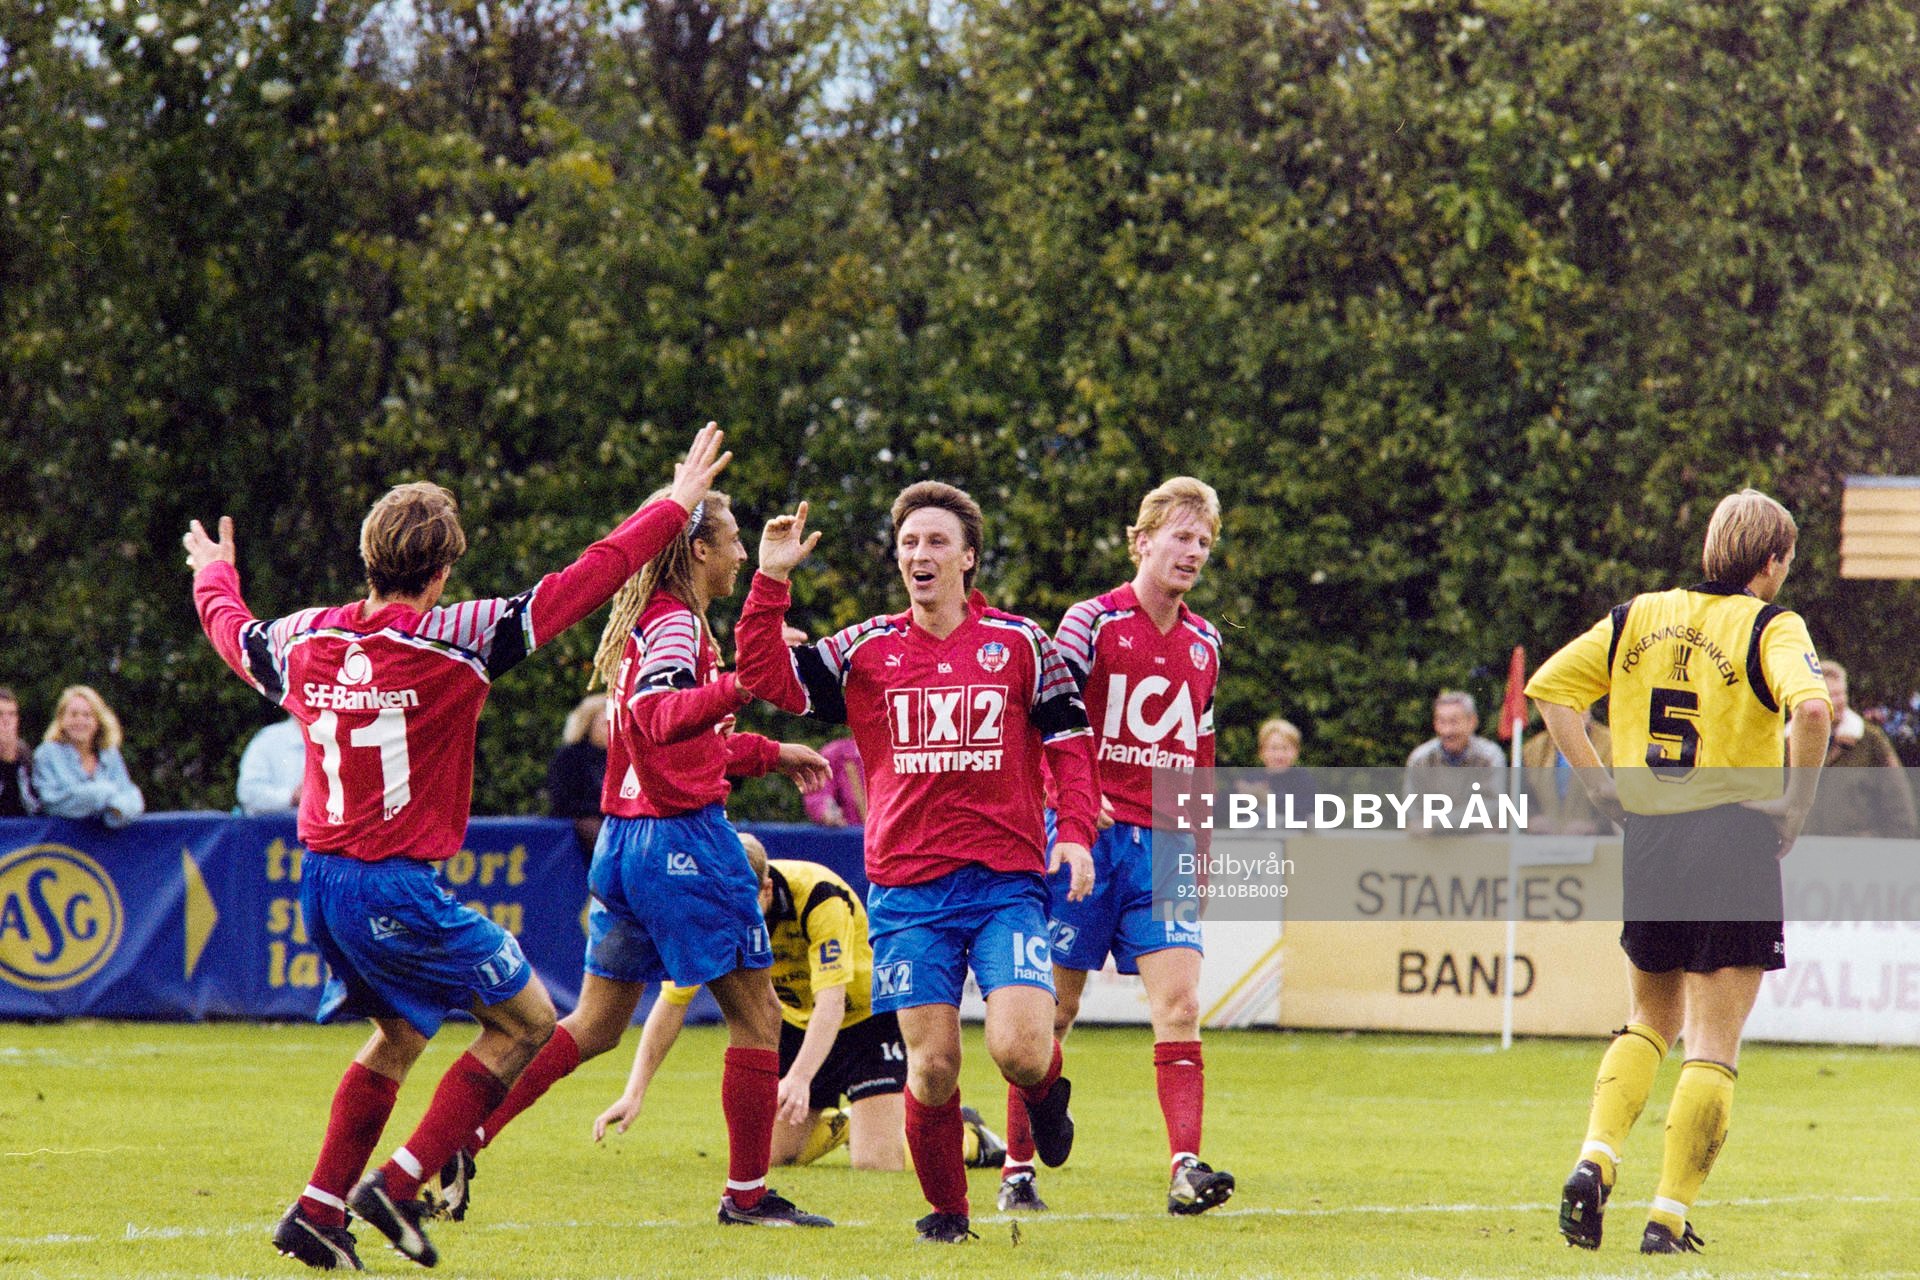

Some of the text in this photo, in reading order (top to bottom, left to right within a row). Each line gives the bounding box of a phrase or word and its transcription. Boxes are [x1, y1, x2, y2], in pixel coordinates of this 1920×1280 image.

[1103, 673, 1197, 751] ICA
[1645, 687, 1703, 784] 5
[307, 709, 412, 825] 11
[893, 750, 1003, 774] STRYKTIPSET
[1098, 737, 1196, 775] handlarna
[667, 852, 698, 870] ICA
[0, 867, 97, 962] ASG
[1398, 951, 1535, 998] BAND
